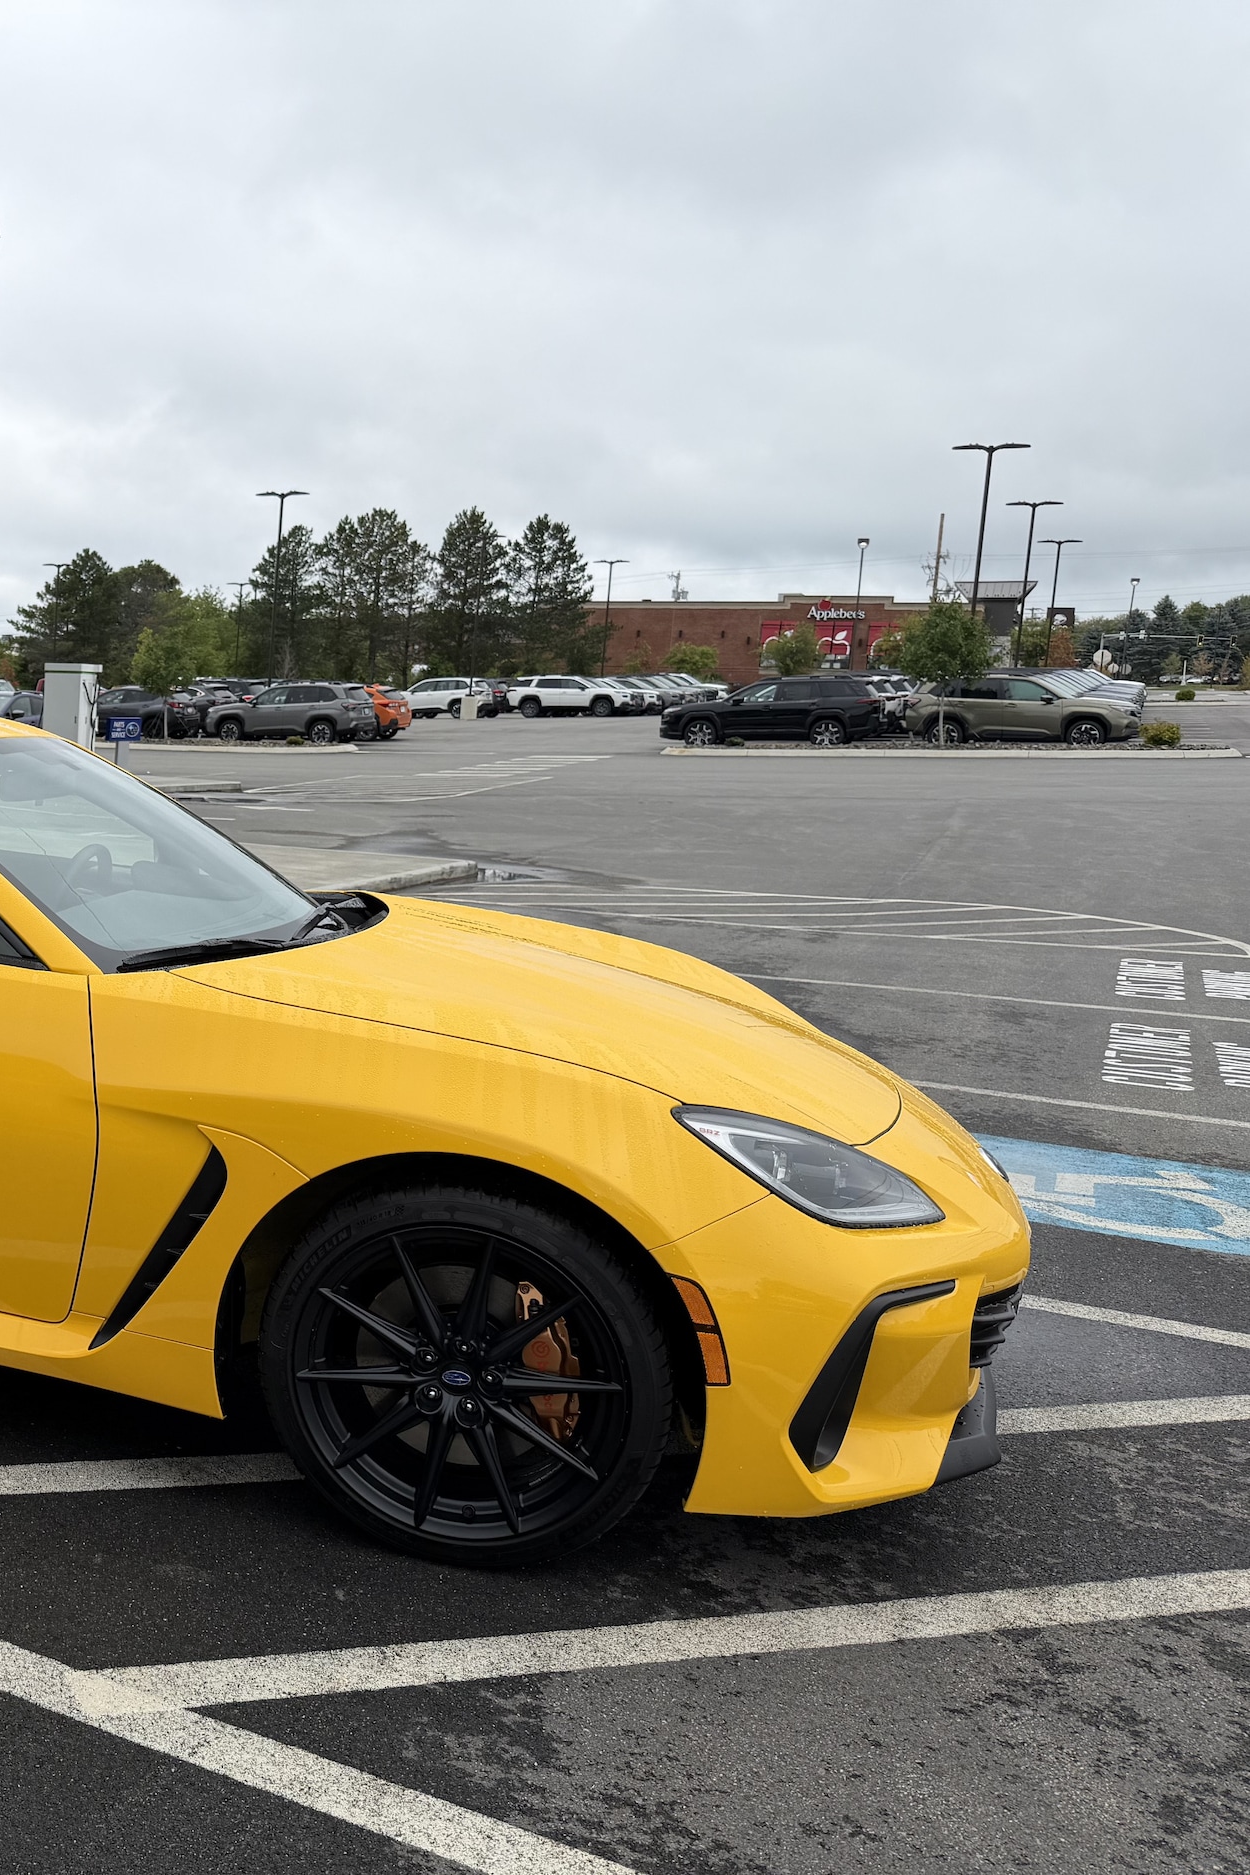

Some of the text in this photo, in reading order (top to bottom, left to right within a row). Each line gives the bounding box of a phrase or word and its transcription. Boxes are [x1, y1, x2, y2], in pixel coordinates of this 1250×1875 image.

[1101, 1021, 1195, 1091] CUSTOMER
[699, 1127, 721, 1137] BRZ
[290, 1228, 349, 1293] MICHELIN
